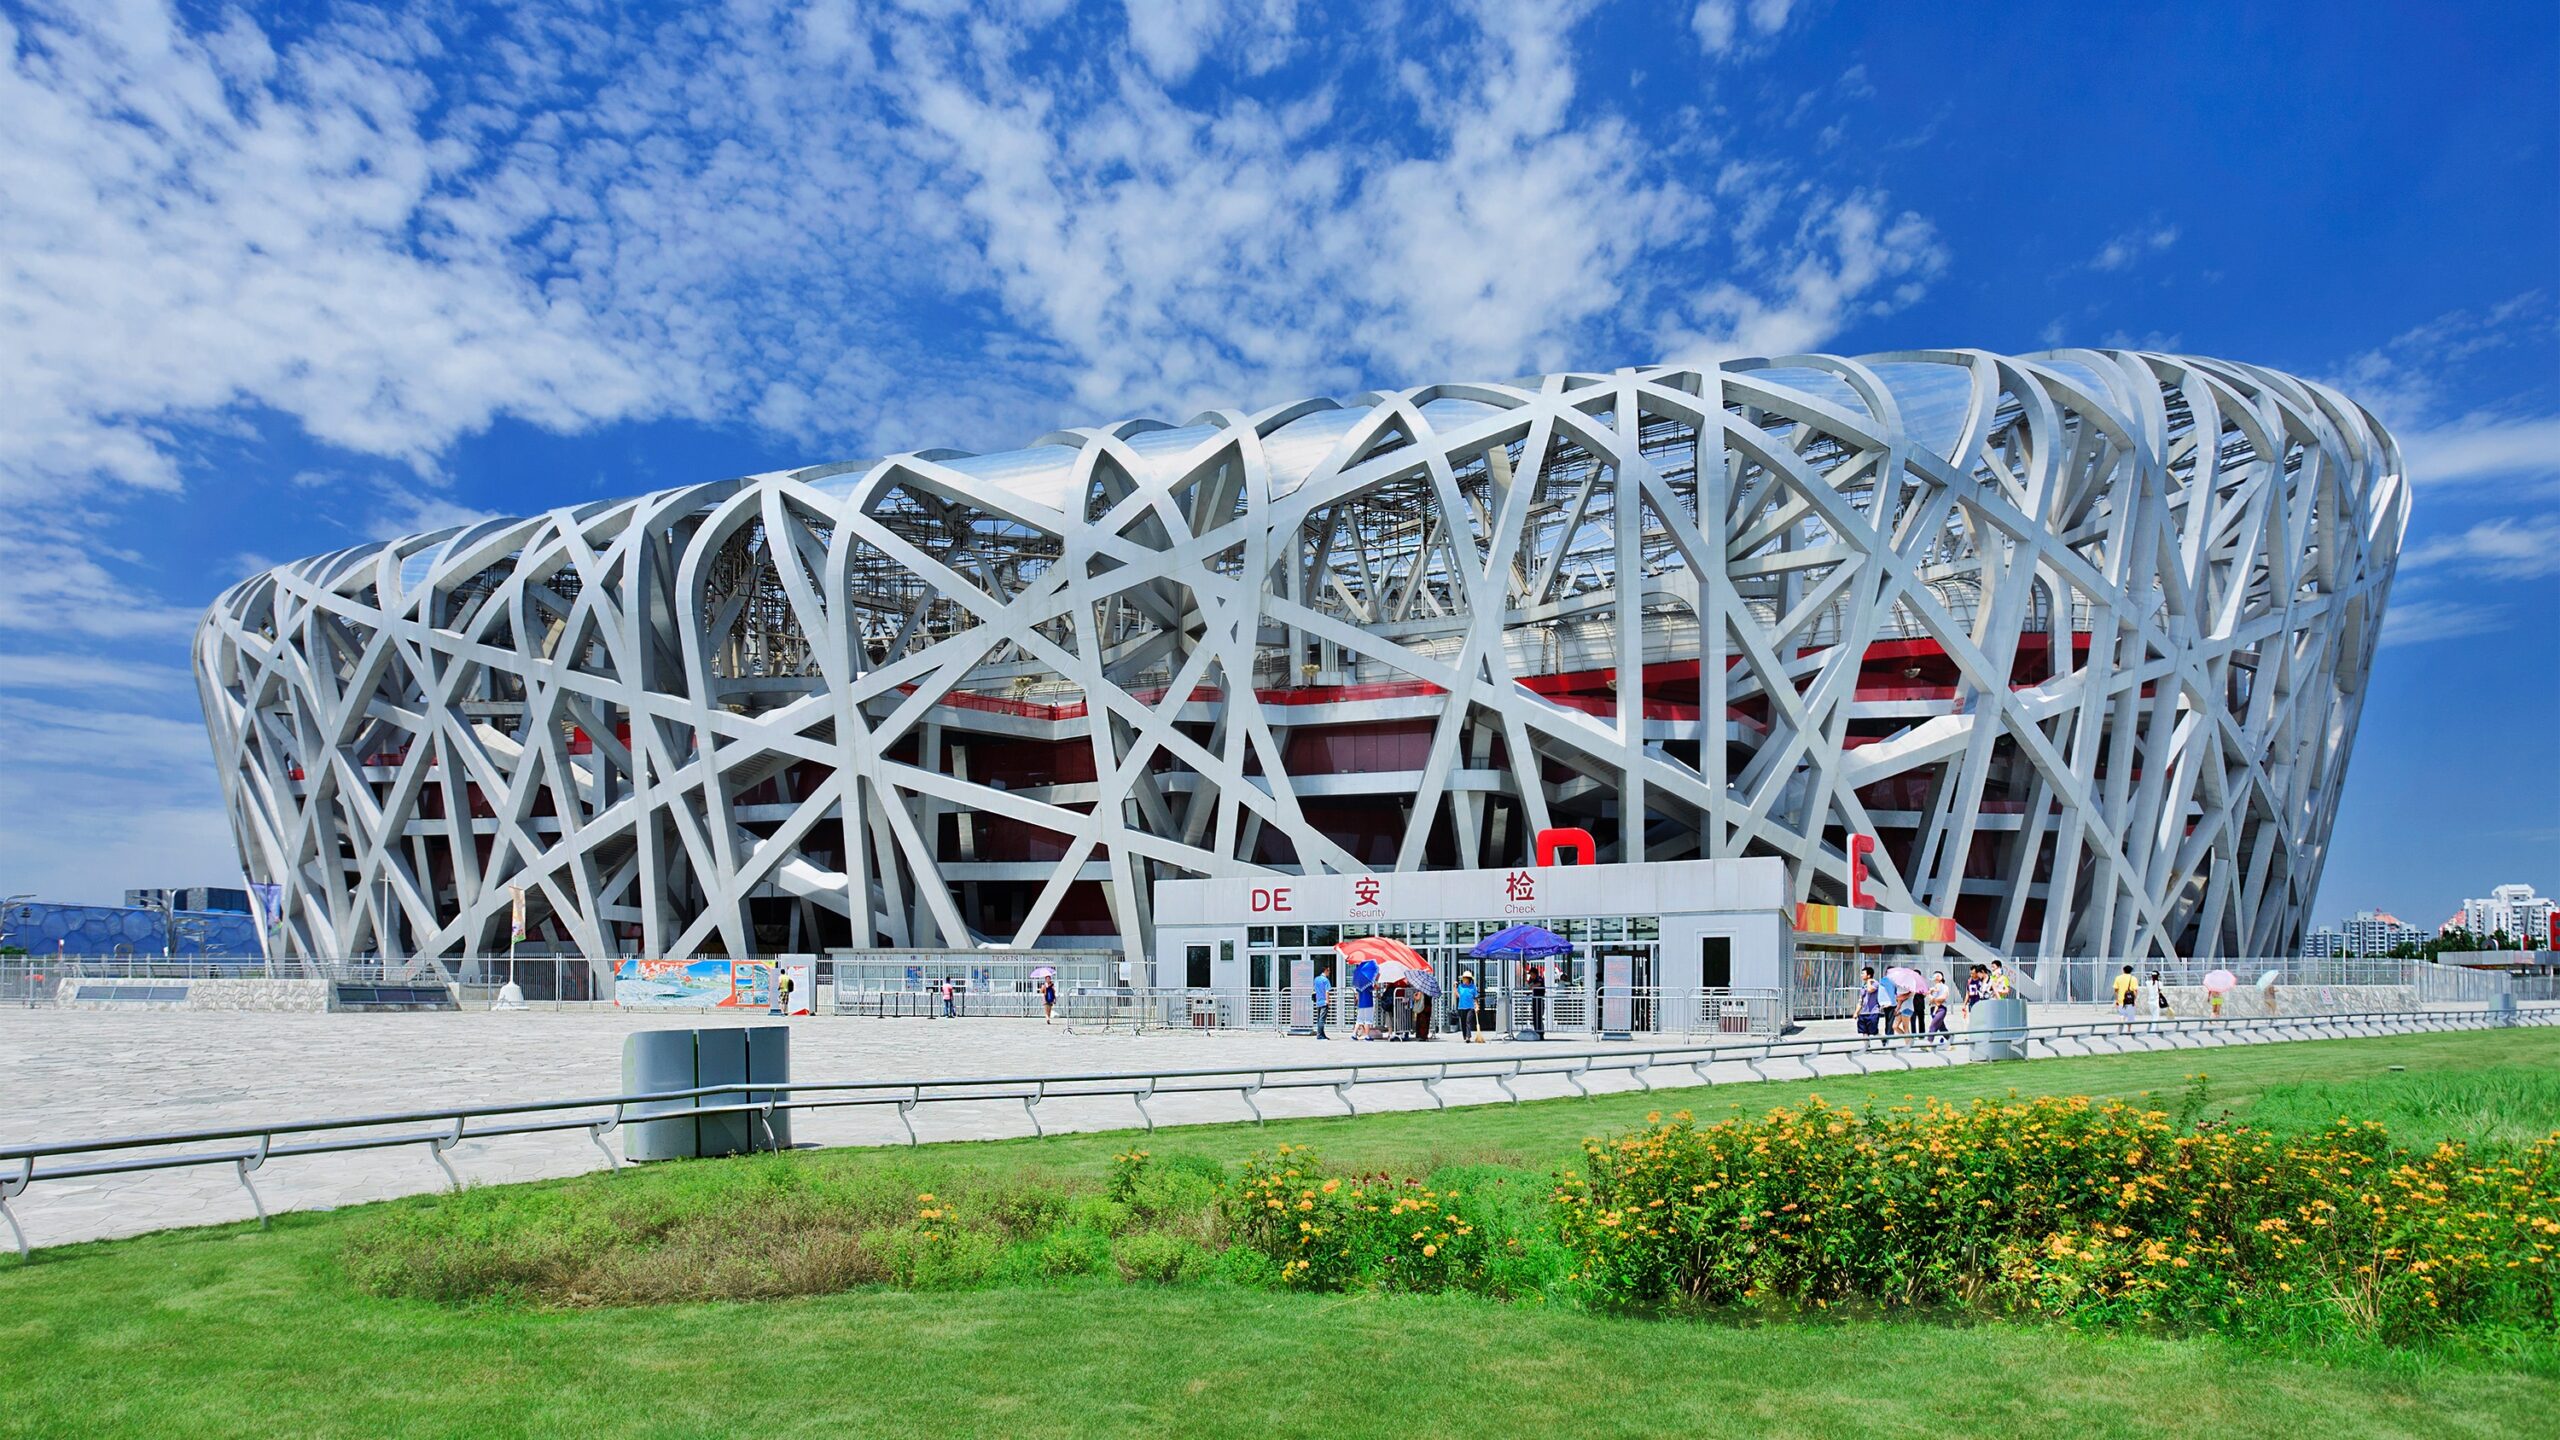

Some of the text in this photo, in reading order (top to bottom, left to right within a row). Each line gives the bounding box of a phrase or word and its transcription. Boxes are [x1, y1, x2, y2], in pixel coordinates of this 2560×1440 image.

[1252, 888, 1292, 912] DE
[1355, 871, 1535, 906] 安 检
[1350, 904, 1536, 919] Security Check
